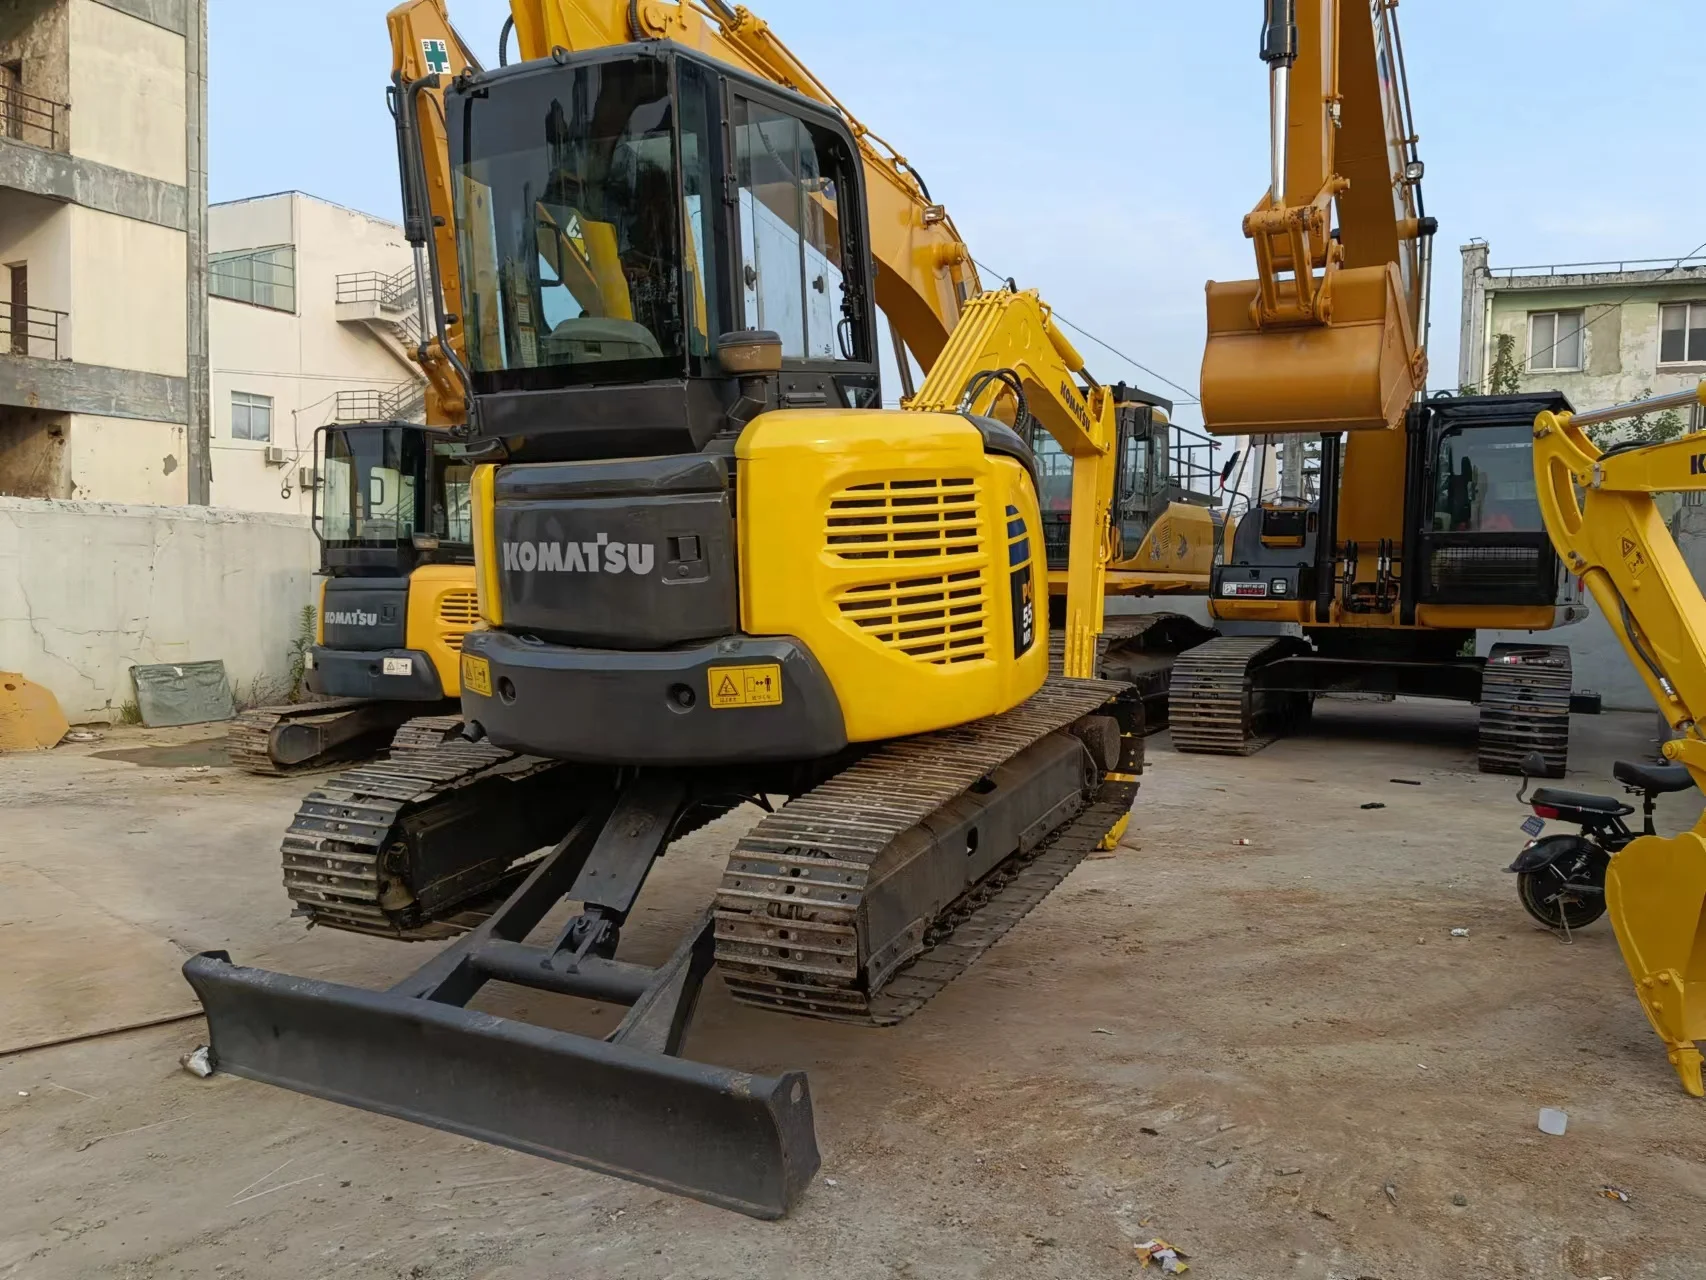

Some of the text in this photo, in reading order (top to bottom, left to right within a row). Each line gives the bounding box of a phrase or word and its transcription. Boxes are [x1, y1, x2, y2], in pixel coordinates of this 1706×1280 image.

[1060, 380, 1091, 433] KOMATSU
[502, 532, 655, 575] KOMATSU
[324, 608, 378, 626] KOMATSU
[1023, 602, 1033, 629] 55
